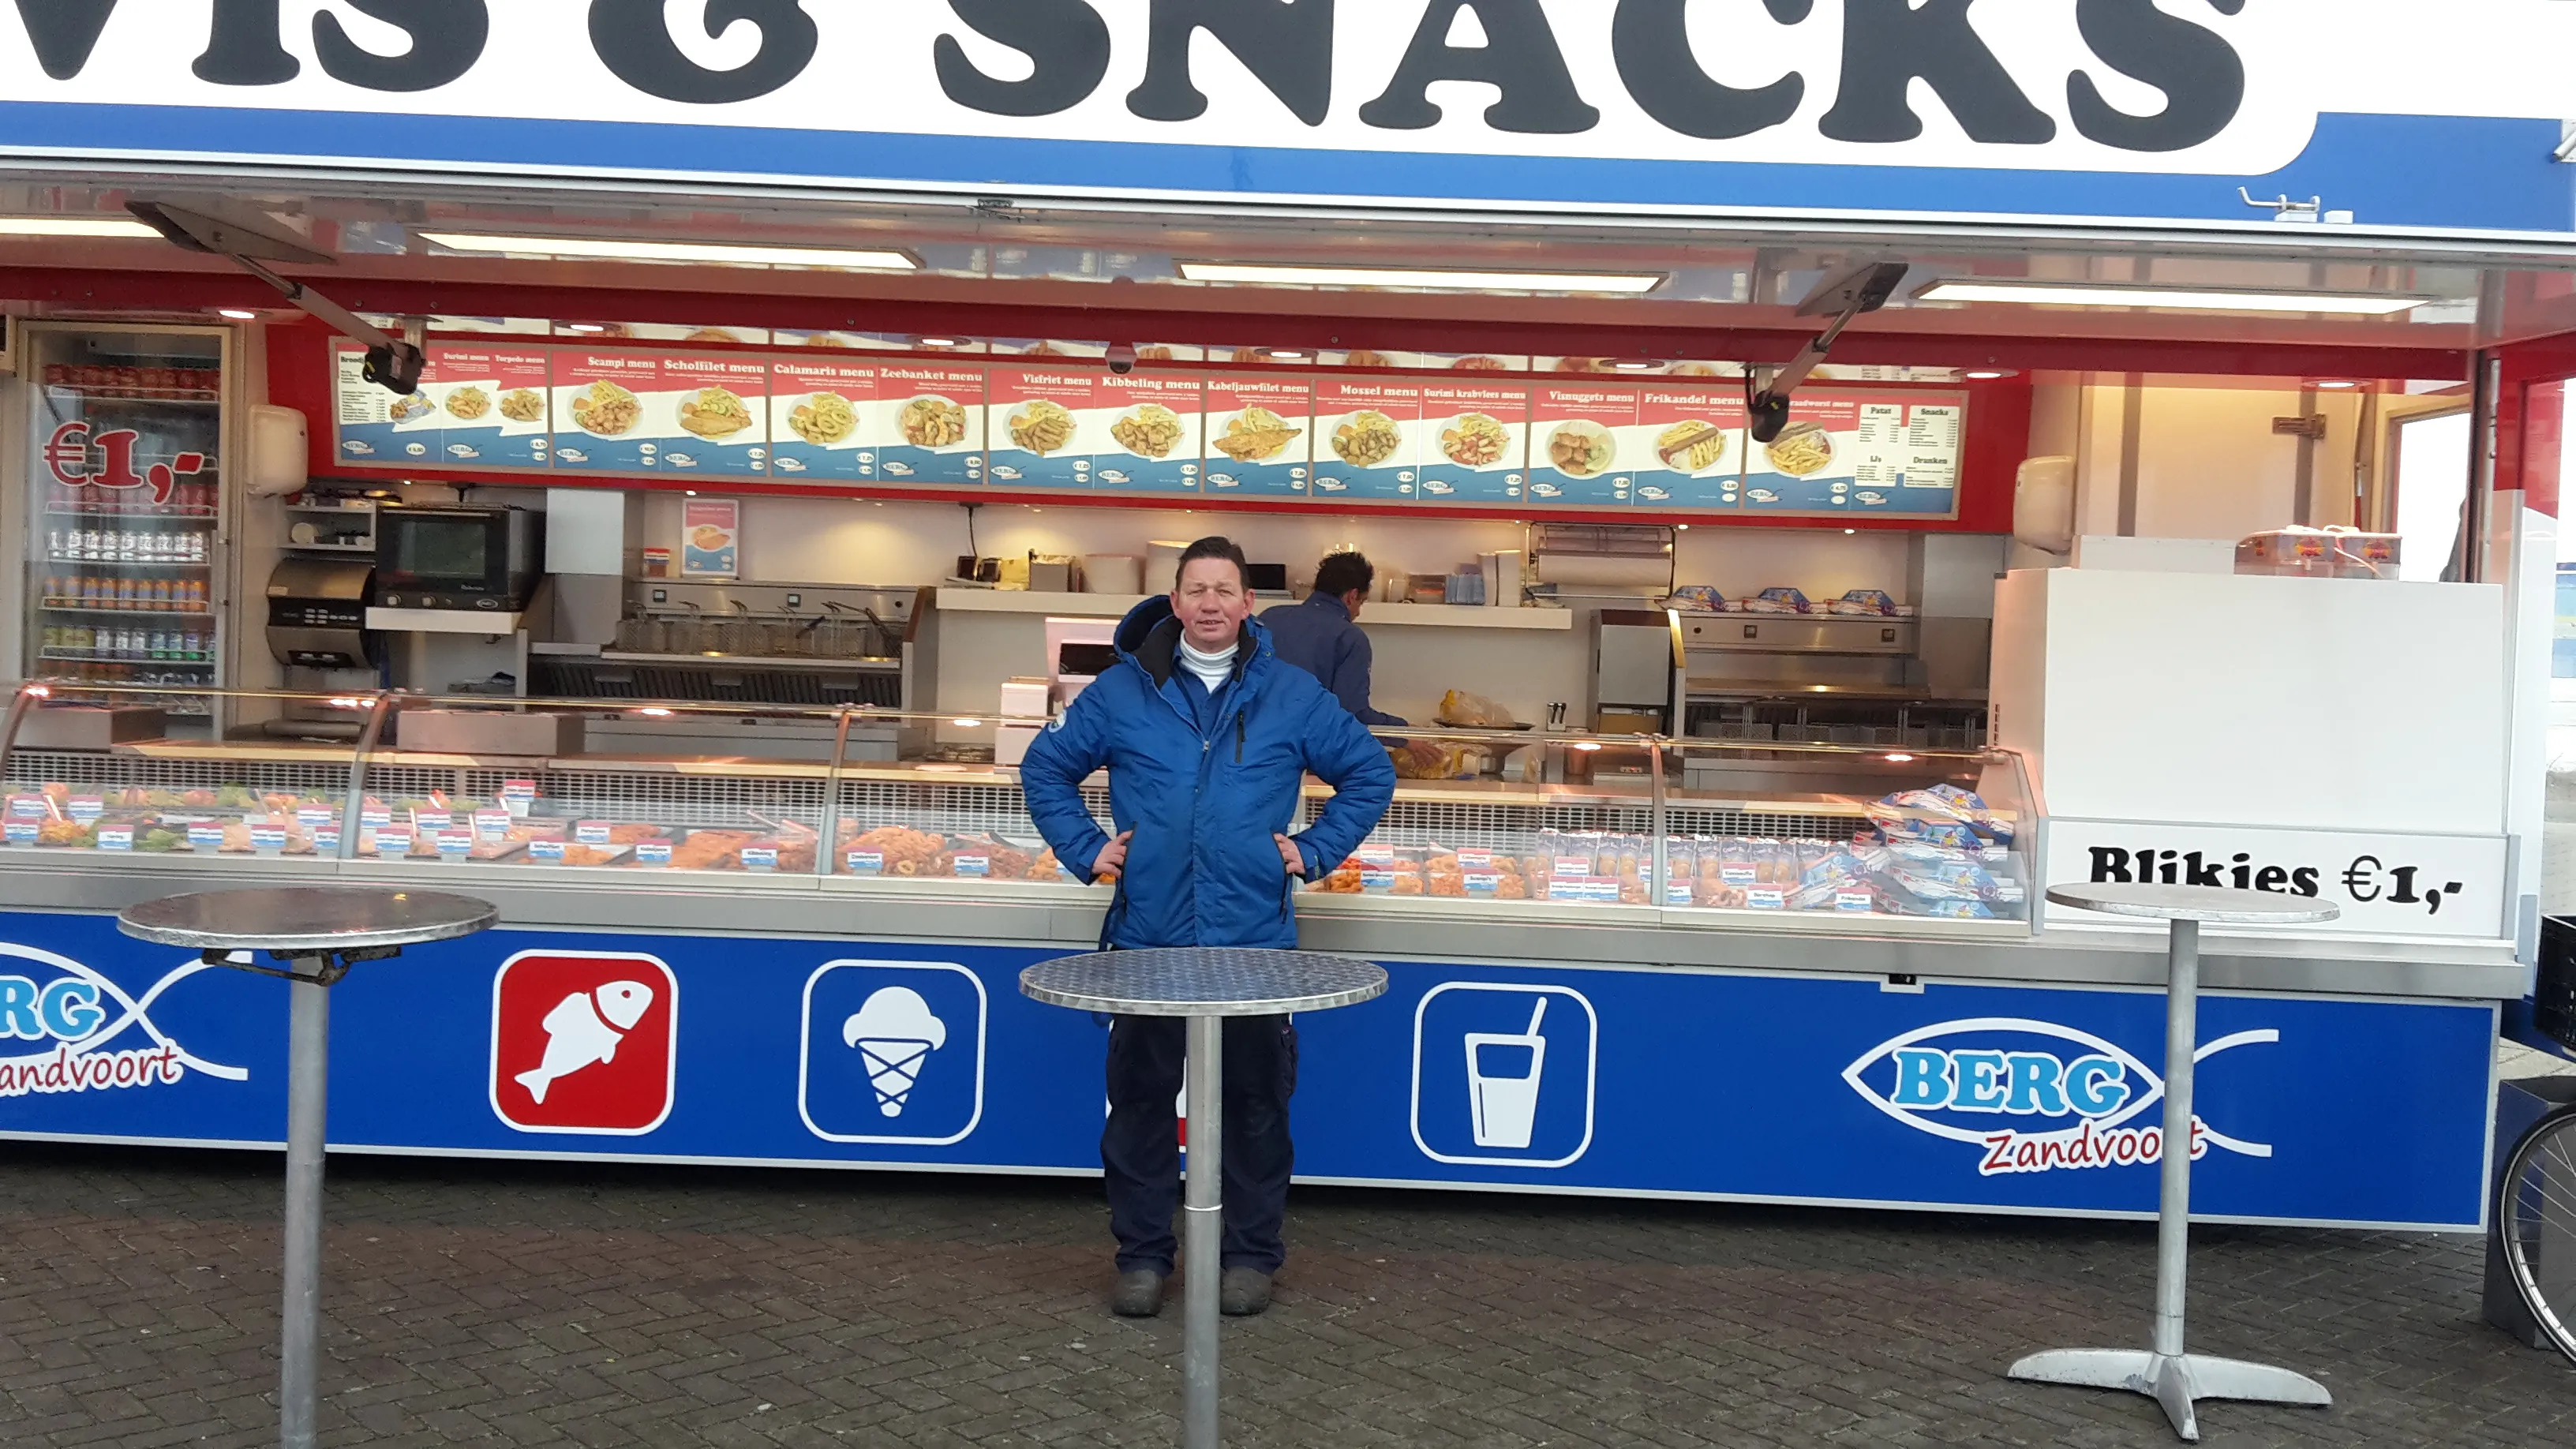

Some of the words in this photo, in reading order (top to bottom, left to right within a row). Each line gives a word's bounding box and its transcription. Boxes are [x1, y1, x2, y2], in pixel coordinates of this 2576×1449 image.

[933, 0, 2244, 152] SNACKS
[588, 357, 625, 369] Scampi
[627, 360, 656, 369] menu
[664, 359, 724, 372] Scholfilet
[729, 364, 765, 373] menu
[774, 364, 837, 376] Calamaris
[840, 369, 874, 377] menu
[880, 368, 945, 380] Zeebanket
[948, 373, 983, 382] menu
[1064, 376, 1091, 386] menu
[1103, 376, 1163, 390] Kibbeling
[1165, 380, 1200, 390] menu
[1208, 380, 1279, 393] Kabeljauwfilet
[1282, 384, 1309, 393] menu
[1341, 384, 1380, 395] Mossel
[1383, 388, 1418, 397] menu
[1424, 388, 1455, 398] Surimi
[1549, 391, 1604, 402] Visnuggets
[1645, 394, 1706, 404] Frikandel
[1709, 396, 1744, 406] menu
[2088, 846, 2320, 897] Blikies
[2342, 854, 2463, 915] €1,-
[0, 1046, 179, 1091] andvoort
[1894, 1050, 2129, 1115] BERG
[1983, 1120, 2205, 1172] Zandvoot
